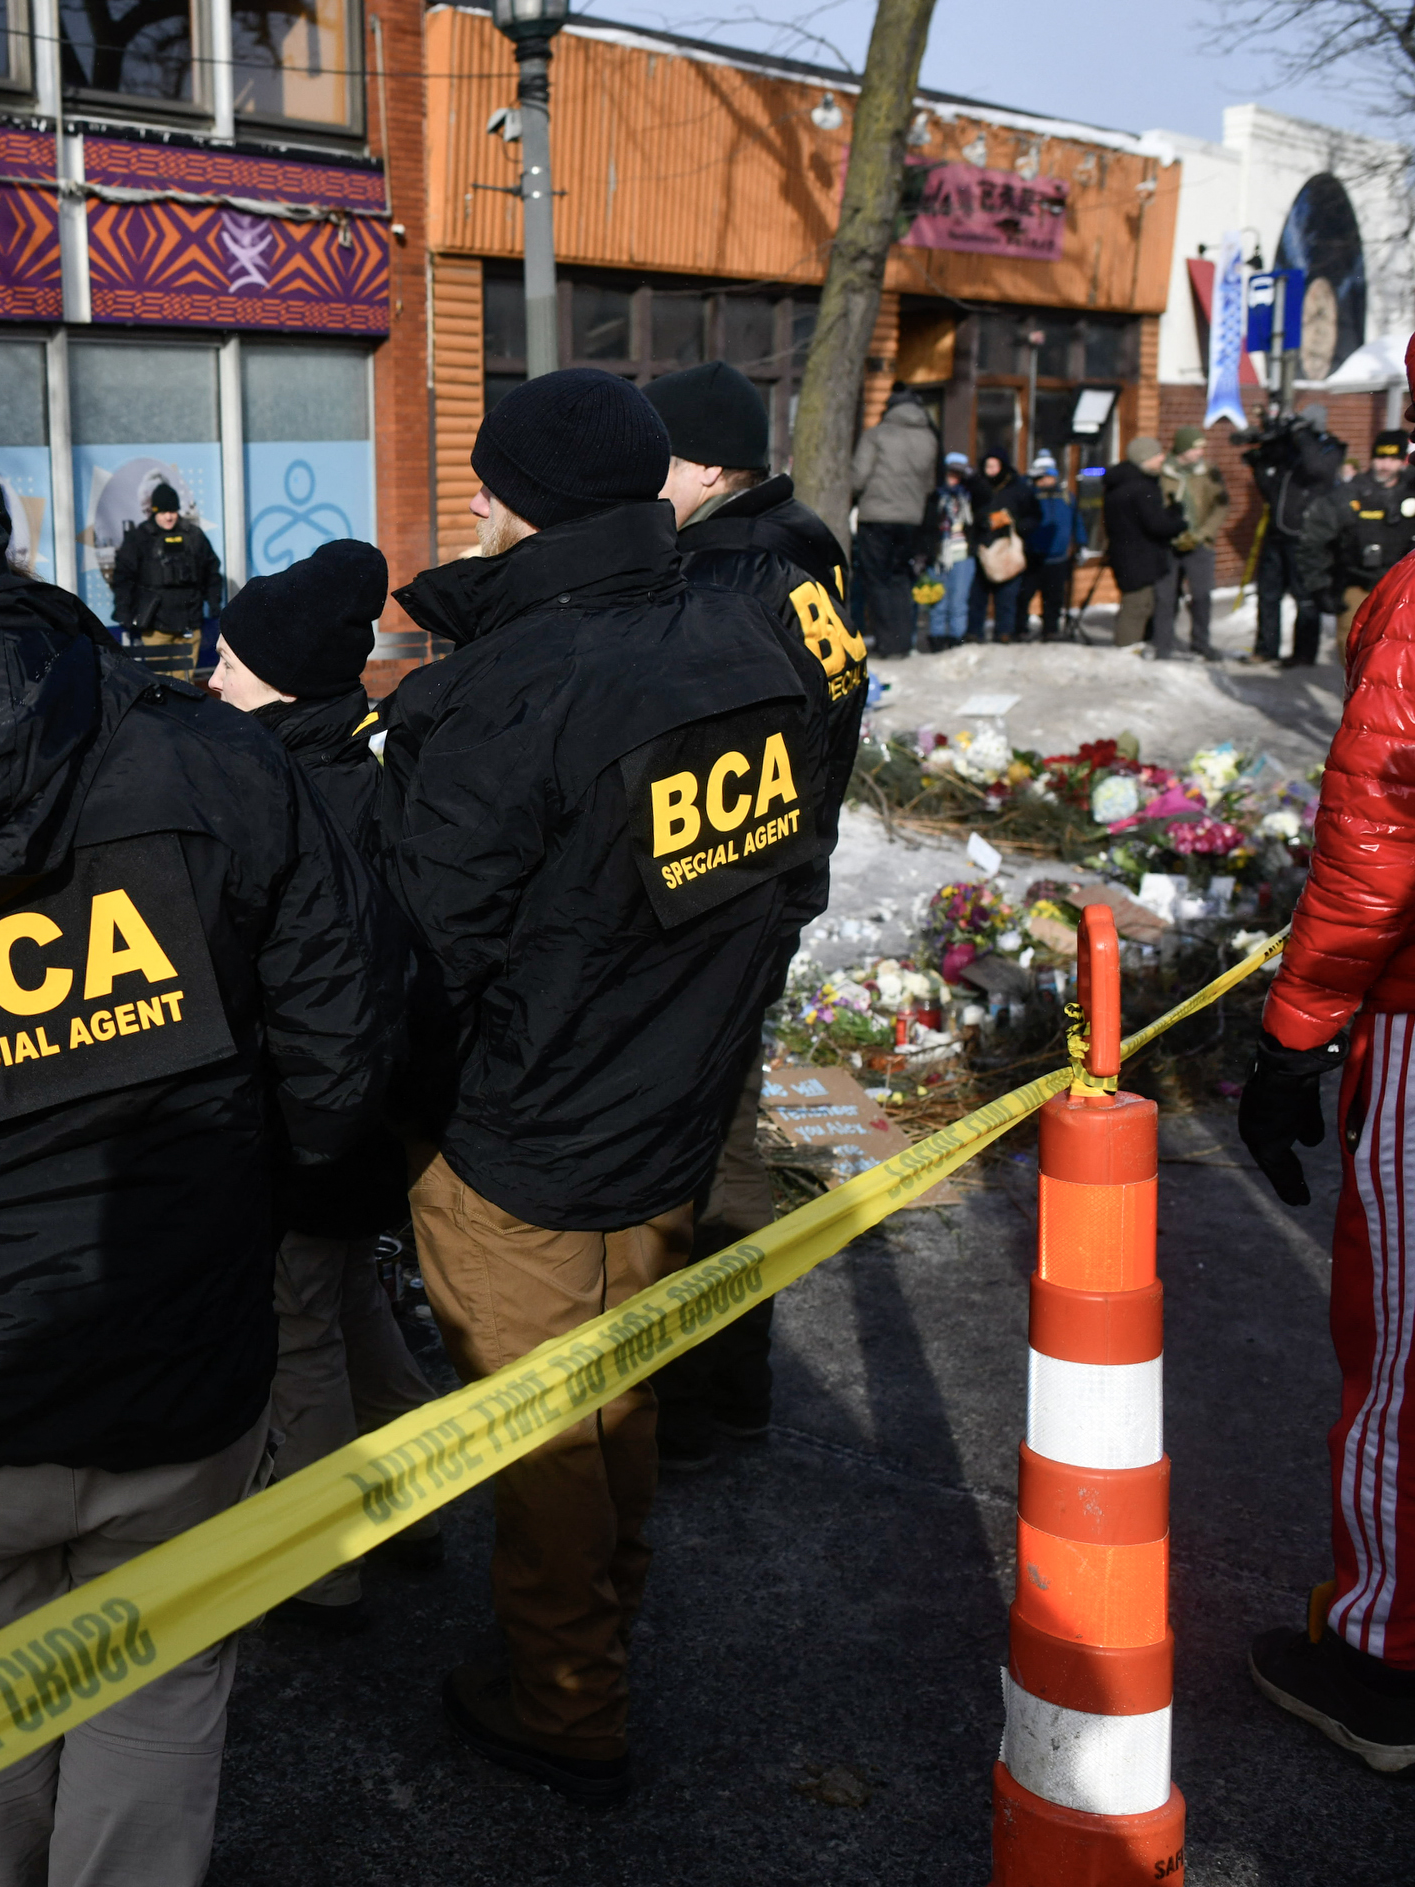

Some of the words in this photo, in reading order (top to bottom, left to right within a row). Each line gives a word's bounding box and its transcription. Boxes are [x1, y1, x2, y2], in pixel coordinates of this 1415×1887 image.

[651, 732, 798, 858] BCA
[661, 840, 739, 890] SPECIAL
[743, 809, 800, 857] AGENT
[69, 990, 184, 1050] AGENT
[1154, 1846, 1184, 1880] SAF
